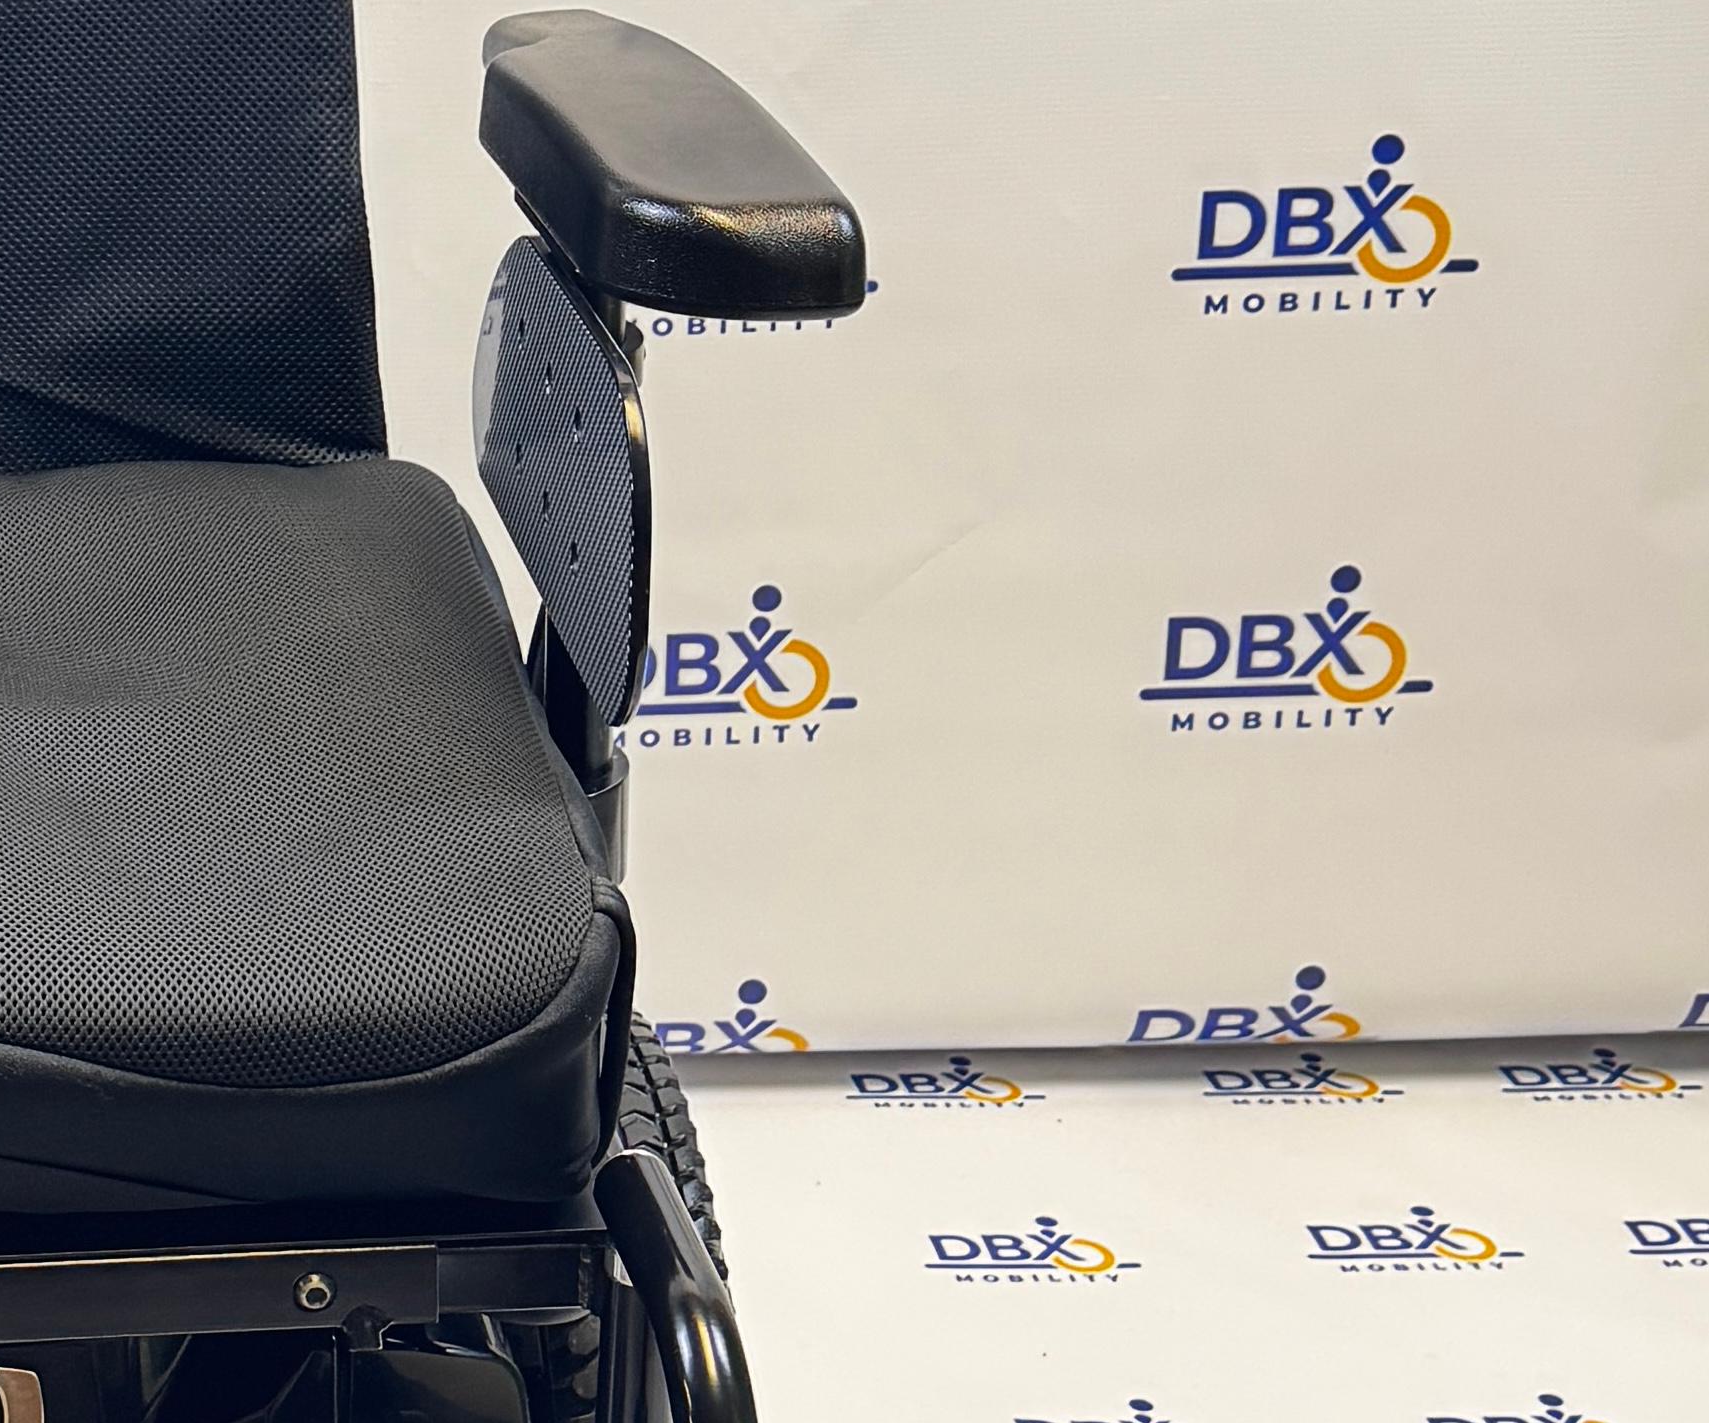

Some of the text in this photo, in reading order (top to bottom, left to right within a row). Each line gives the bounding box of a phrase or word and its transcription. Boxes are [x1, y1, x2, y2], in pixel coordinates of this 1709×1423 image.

[1196, 183, 1414, 261] DBX
[1203, 287, 1437, 315] MOBILITY
[1163, 610, 1371, 681] DBX
[1171, 706, 1394, 732] MOBILITY
[1306, 1223, 1467, 1252] DBX
[1624, 1218, 1709, 1247] DB
[927, 1232, 1090, 1263] DBX
